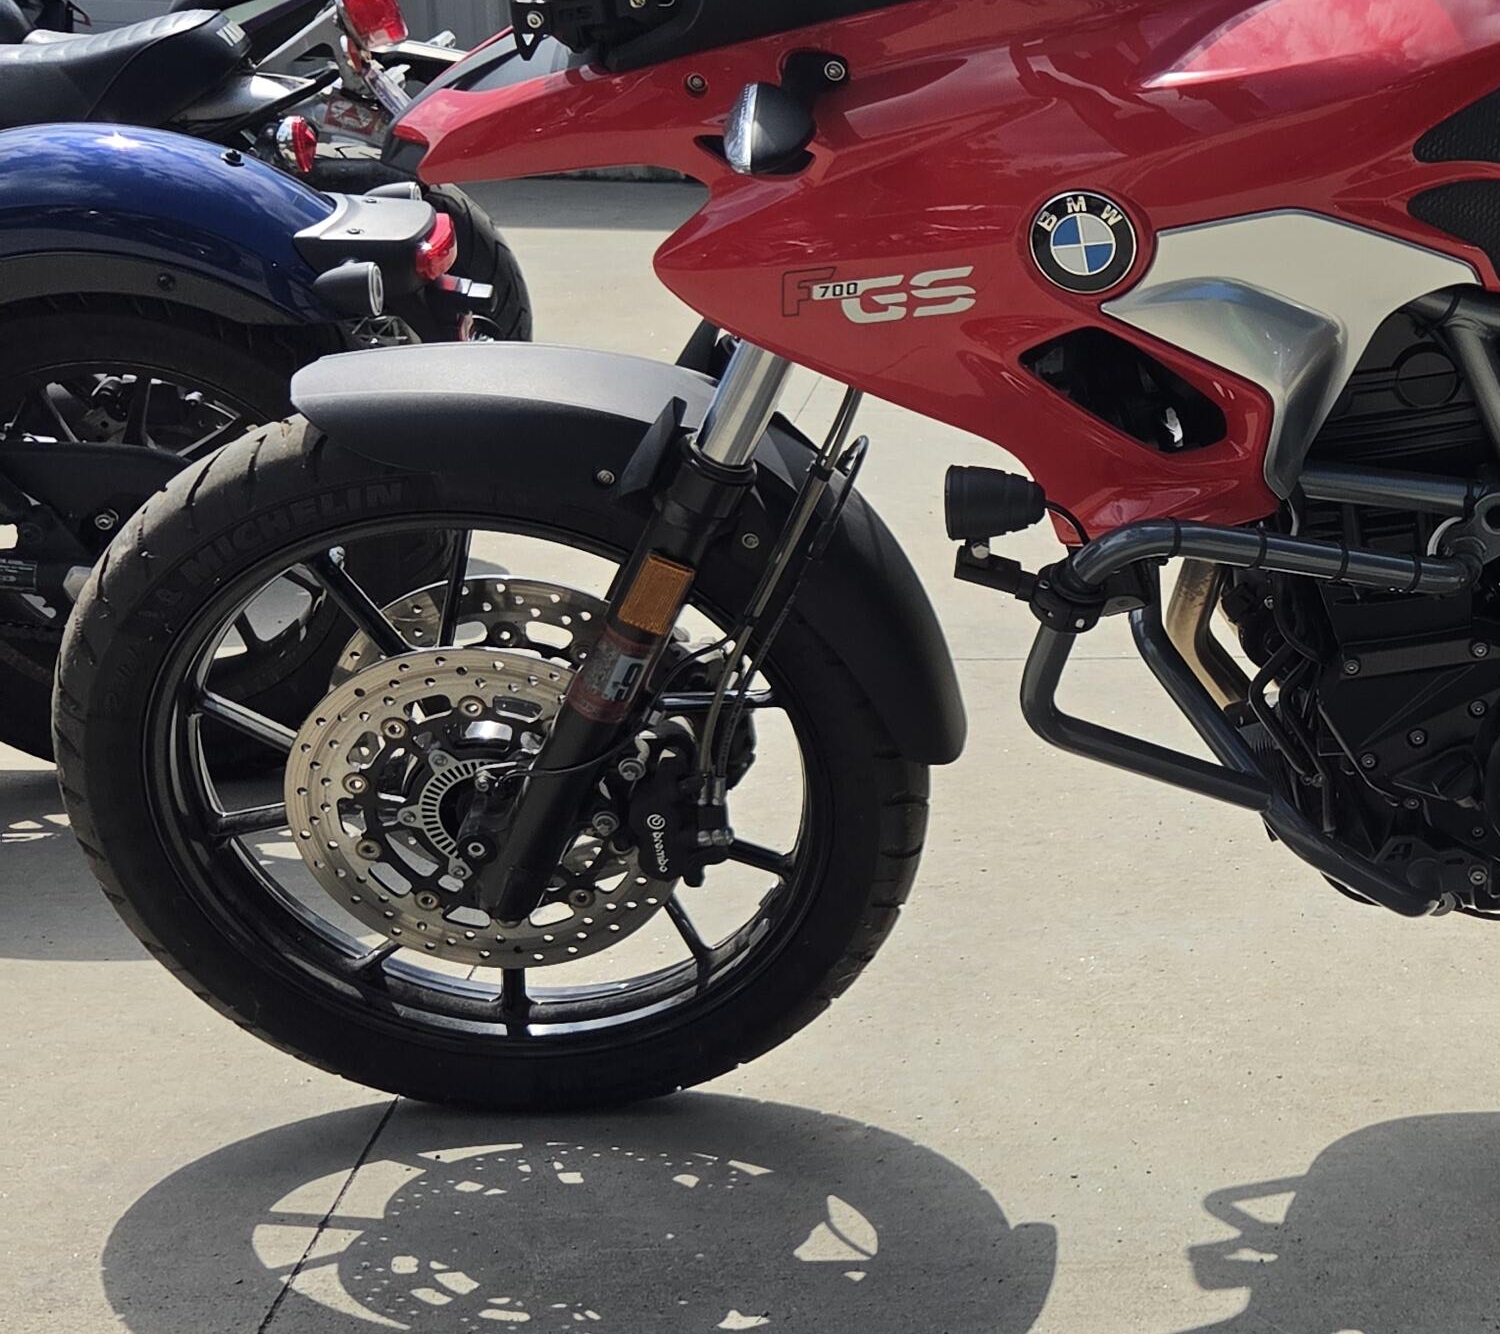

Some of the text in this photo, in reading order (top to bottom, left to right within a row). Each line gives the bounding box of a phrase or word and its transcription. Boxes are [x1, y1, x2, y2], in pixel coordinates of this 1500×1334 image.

[1037, 195, 1123, 232] BMW
[819, 282, 858, 298] 700
[841, 265, 977, 324] GS
[181, 481, 404, 586] MICHELIN
[651, 830, 670, 874] brembo
